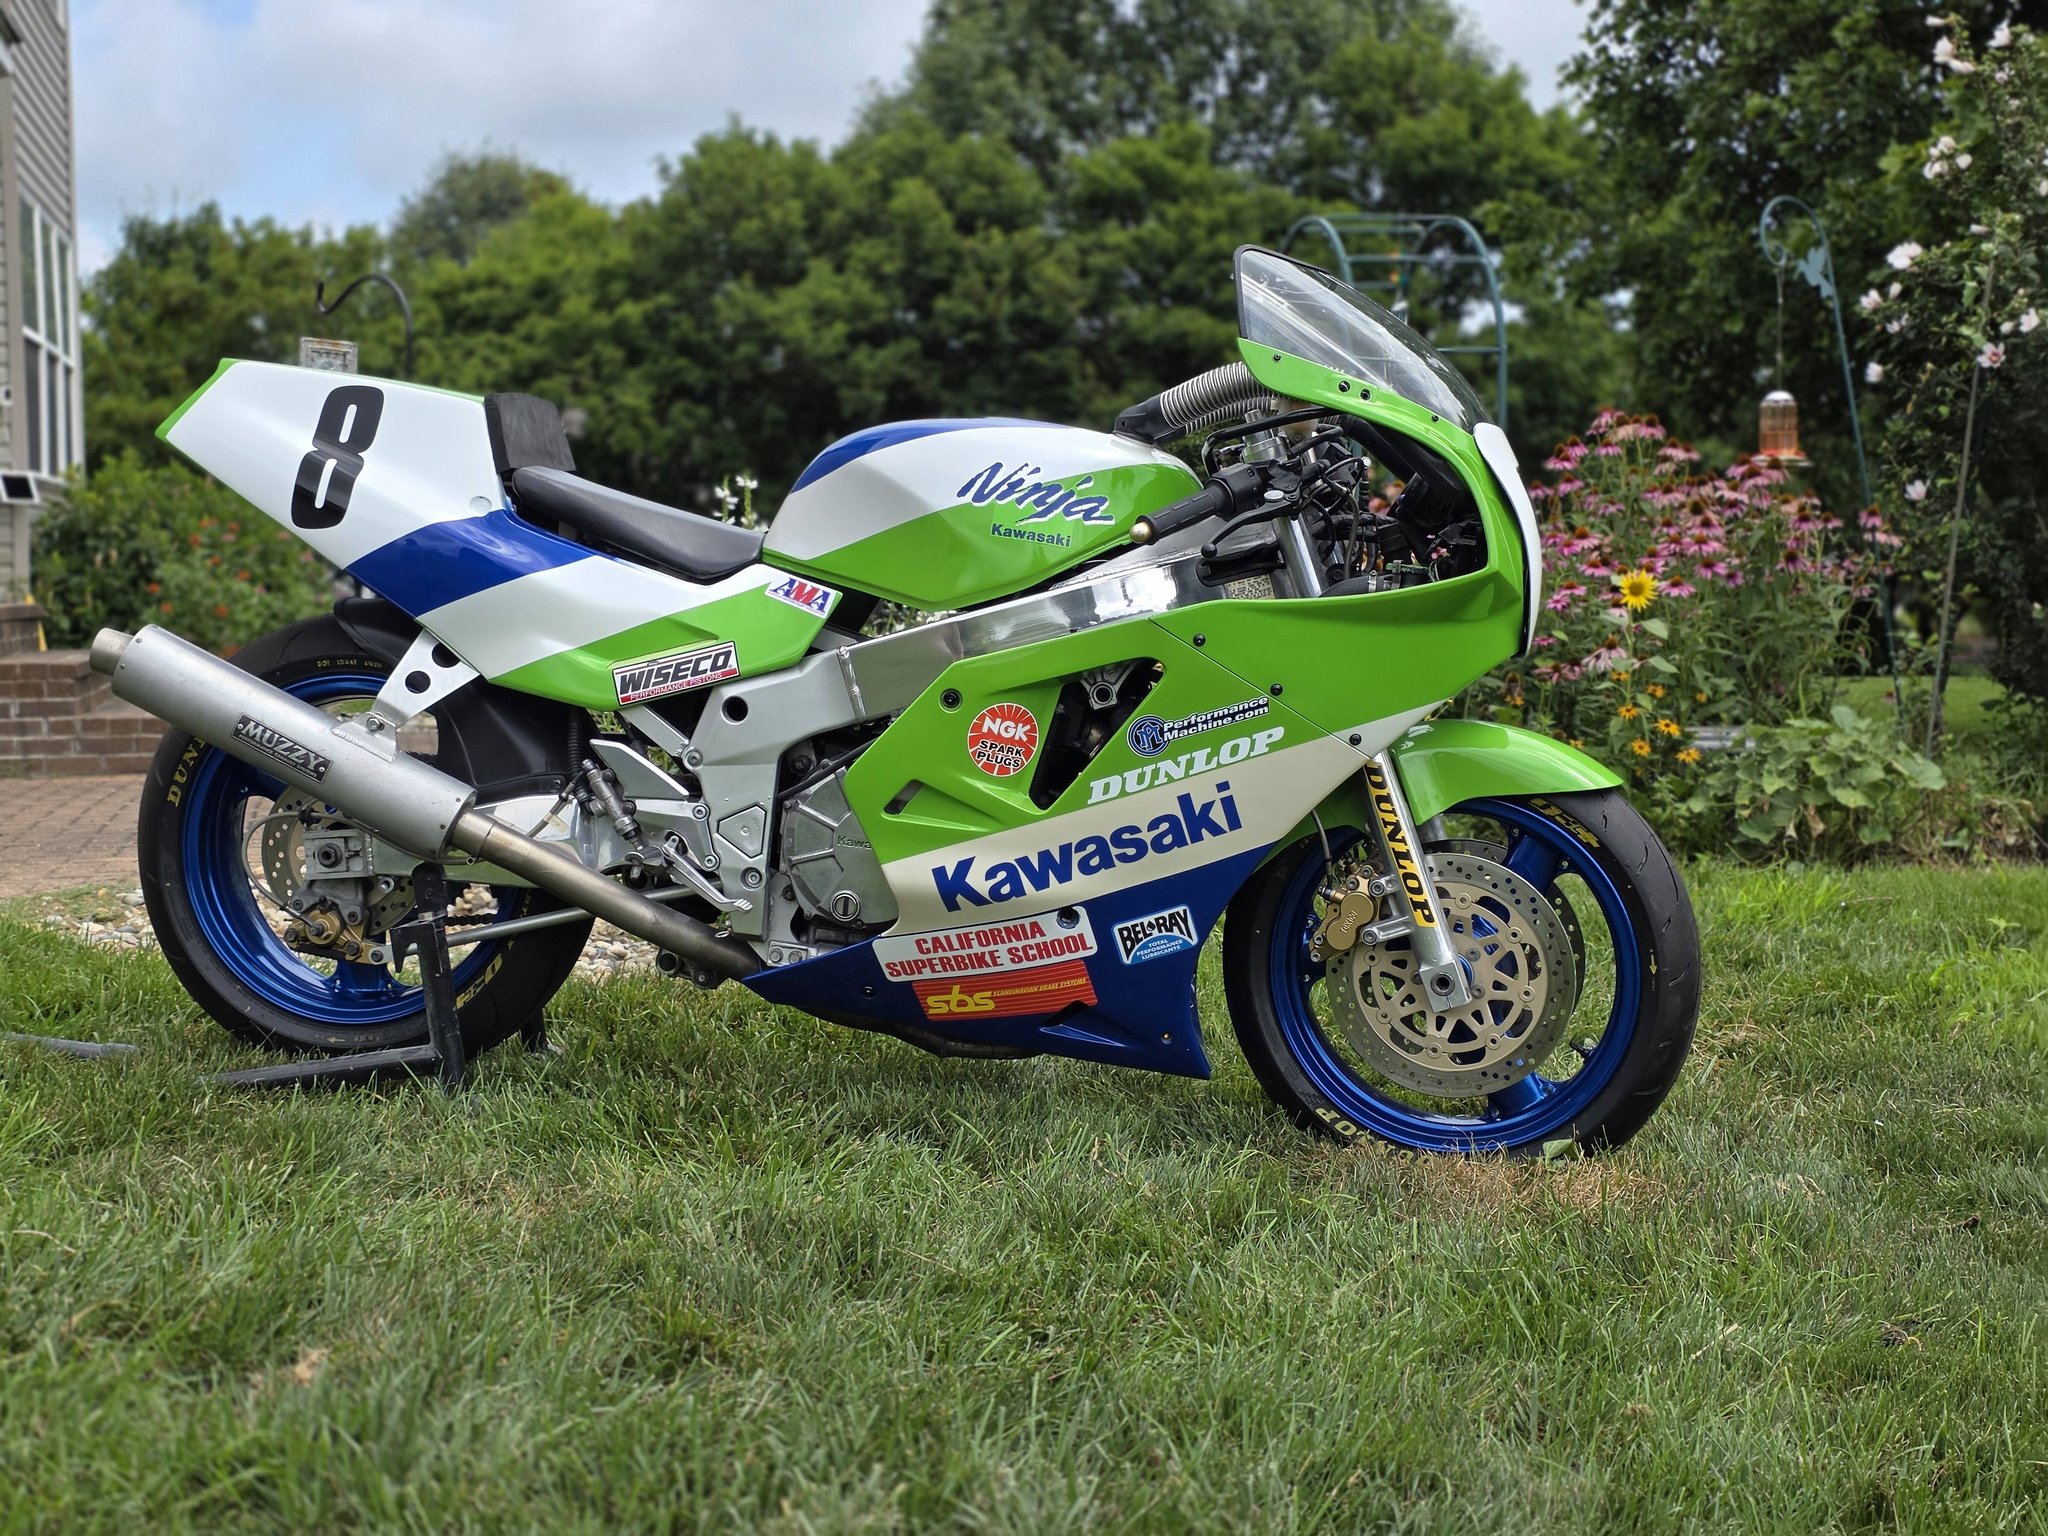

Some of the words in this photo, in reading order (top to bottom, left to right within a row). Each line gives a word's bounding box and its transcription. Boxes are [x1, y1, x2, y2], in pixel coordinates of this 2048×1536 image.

[291, 385, 385, 529] 8
[956, 461, 1115, 526] Ninja
[991, 523, 1072, 547] Kawasaki
[769, 577, 826, 613] AMA
[619, 649, 732, 695] WISECO
[630, 681, 689, 700] PERFORMANCE
[689, 673, 723, 686] PISTONS
[981, 716, 1031, 742] NGK
[1163, 697, 1269, 732] Performance
[1163, 706, 1269, 741] Machine.com
[241, 721, 325, 770] MUZZY
[976, 750, 1021, 768] PLUGS
[979, 740, 1024, 758] SPARK
[1087, 727, 1285, 804] DUNLOP
[931, 780, 1243, 912] Kawasaki
[1364, 764, 1436, 924] DUNLOP
[915, 920, 1046, 955] CALIFORNIA
[1136, 939, 1183, 956] PERFORMANCE
[1141, 944, 1181, 960] LUBRICANTS
[1148, 938, 1169, 948] TOTAL
[885, 949, 1004, 978] SUPERBIKE
[1009, 933, 1093, 964] SCHOOL
[926, 985, 996, 1014] sbs
[992, 986, 1039, 997] SCANDINAVIAN
[1039, 983, 1060, 992] BRAKE
[1059, 977, 1087, 988] SYSTEMS
